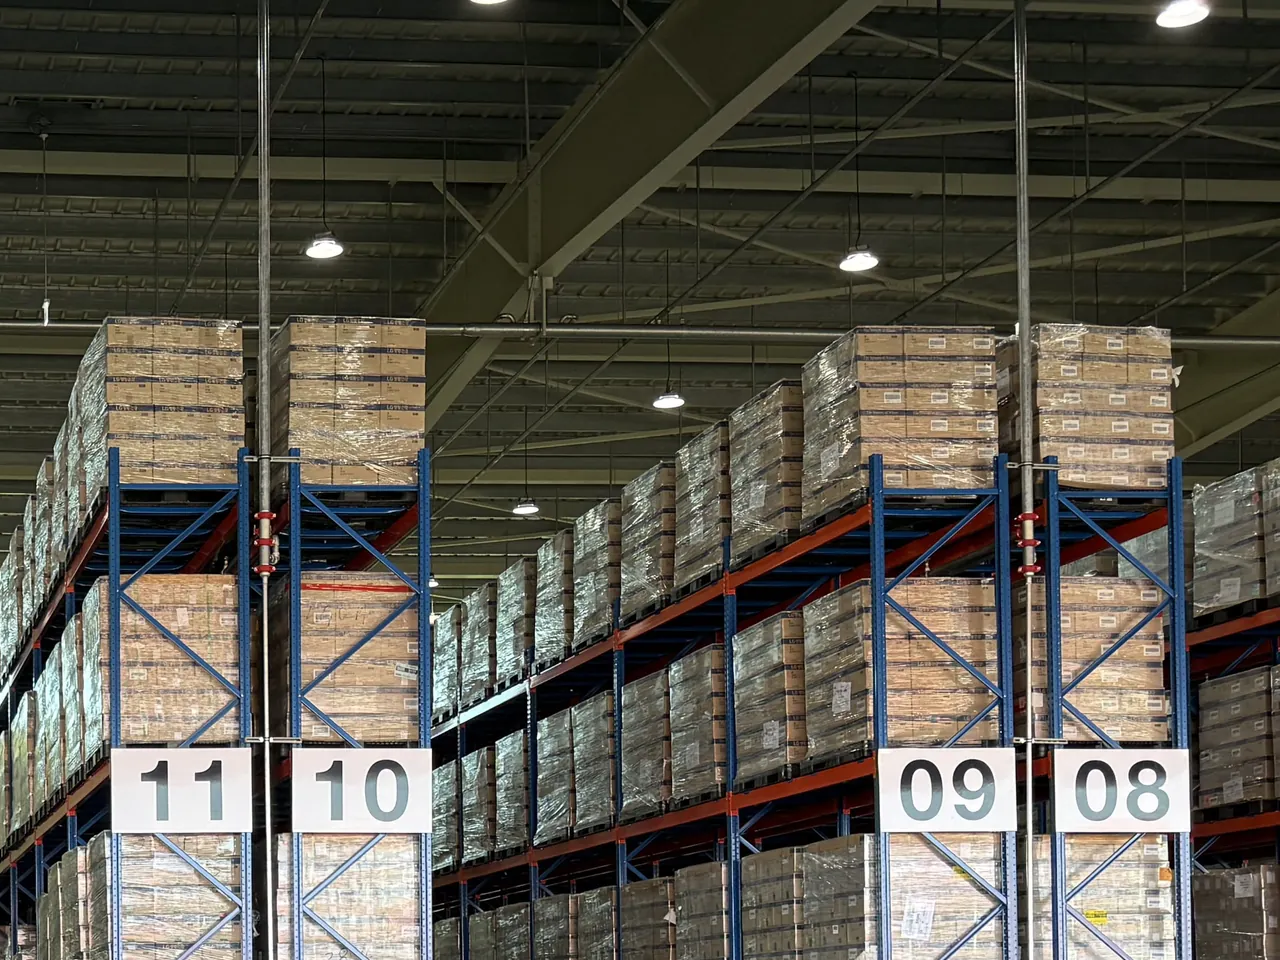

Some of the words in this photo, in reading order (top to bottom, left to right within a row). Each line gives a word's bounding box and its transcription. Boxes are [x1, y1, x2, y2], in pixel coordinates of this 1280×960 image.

[141, 760, 223, 820] 11
[316, 760, 409, 821] 10
[900, 759, 996, 820] 09
[1076, 760, 1170, 821] 08
